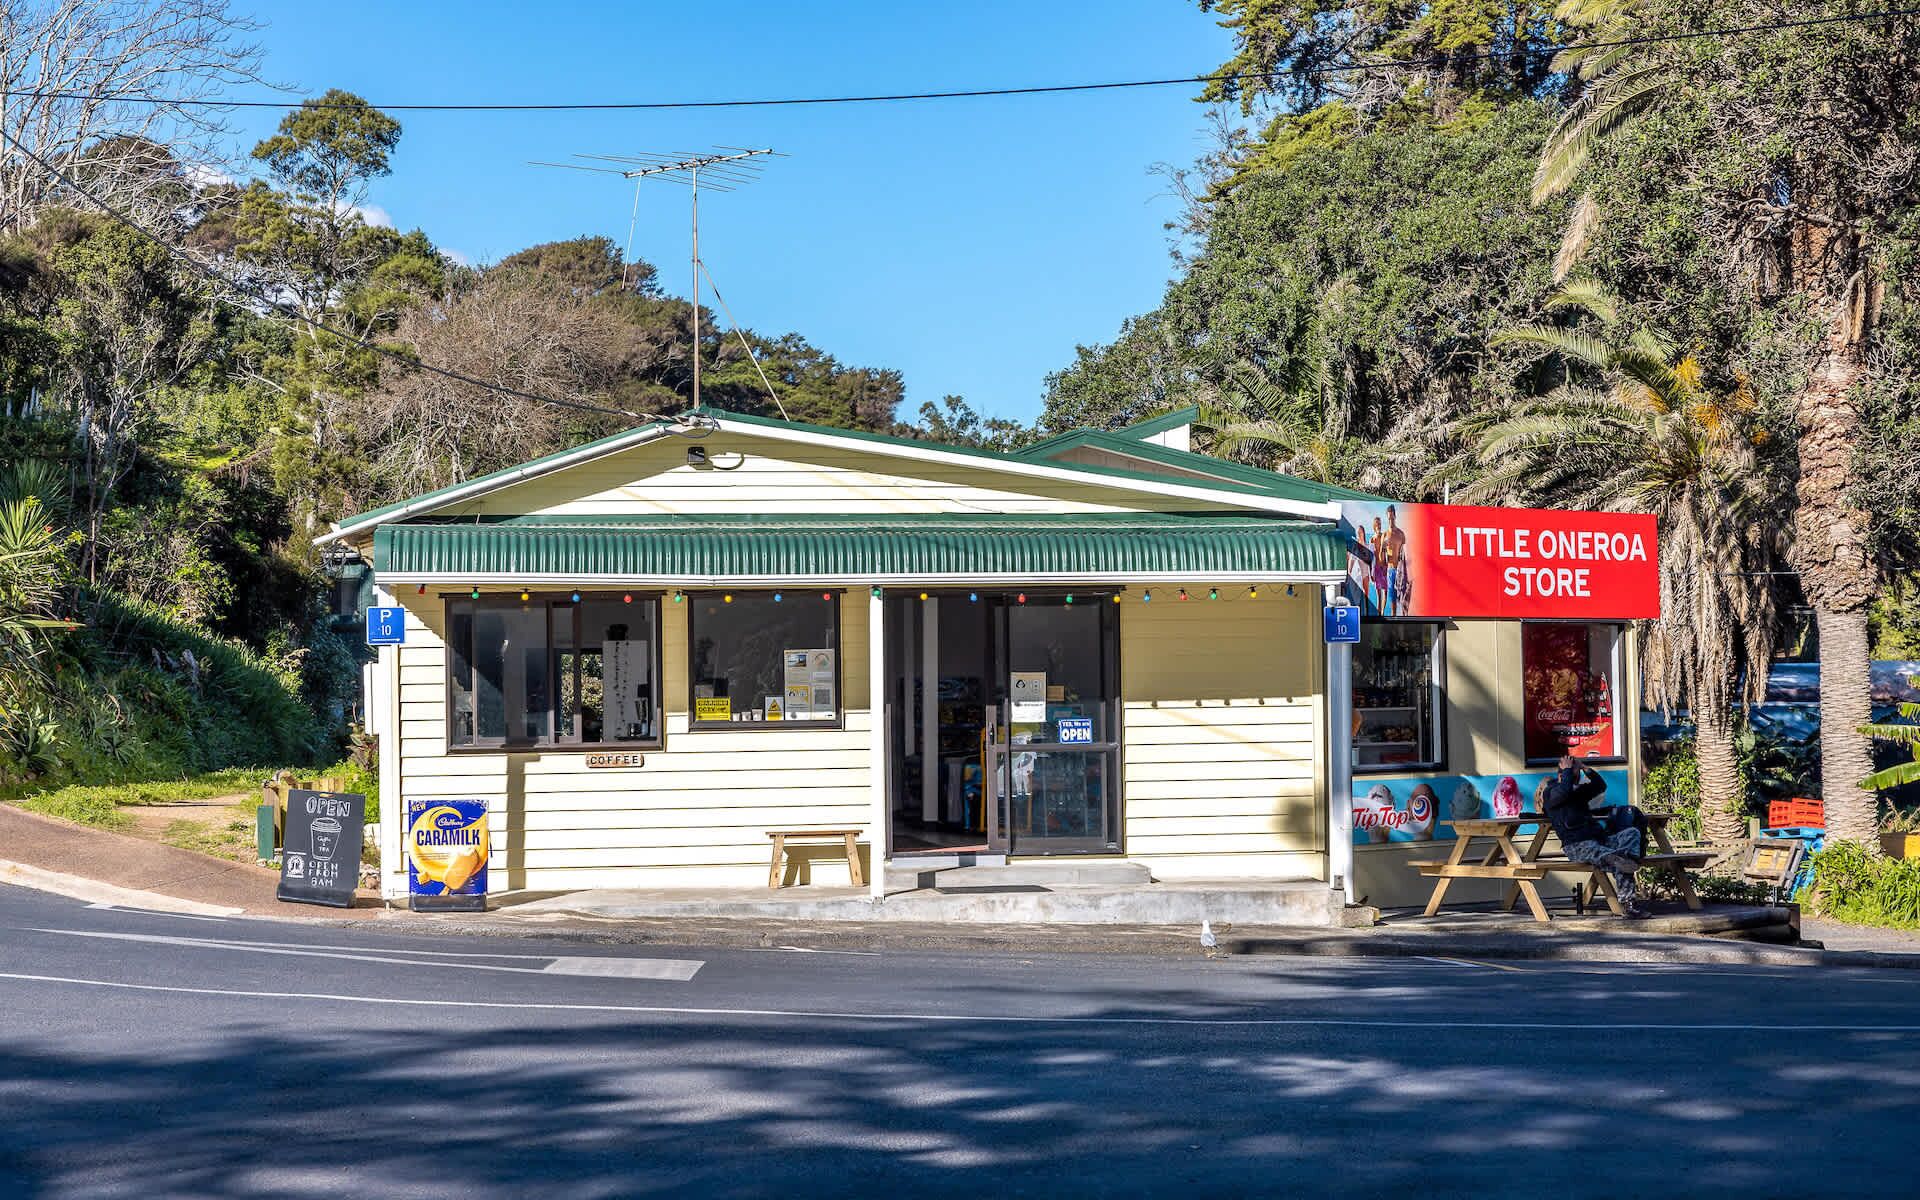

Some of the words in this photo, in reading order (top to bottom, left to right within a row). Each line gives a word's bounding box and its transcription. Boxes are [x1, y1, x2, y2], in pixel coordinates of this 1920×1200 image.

[1439, 526, 1531, 558] LITTLE
[1538, 529, 1647, 562] ONEROA
[1503, 566, 1591, 597] STORE
[380, 609, 392, 623] P
[1336, 608, 1348, 622] P
[381, 624, 392, 636] 10
[1337, 624, 1348, 635] 10
[1061, 728, 1090, 741] OPEN
[590, 755, 639, 764] COFFEE
[306, 796, 351, 817] OPEN
[411, 802, 426, 812] NEW
[1352, 807, 1379, 831] Tip
[1379, 806, 1409, 829] Top
[416, 829, 480, 846] CARAMILK
[309, 861, 338, 870] OPEN
[309, 869, 338, 878] FROM
